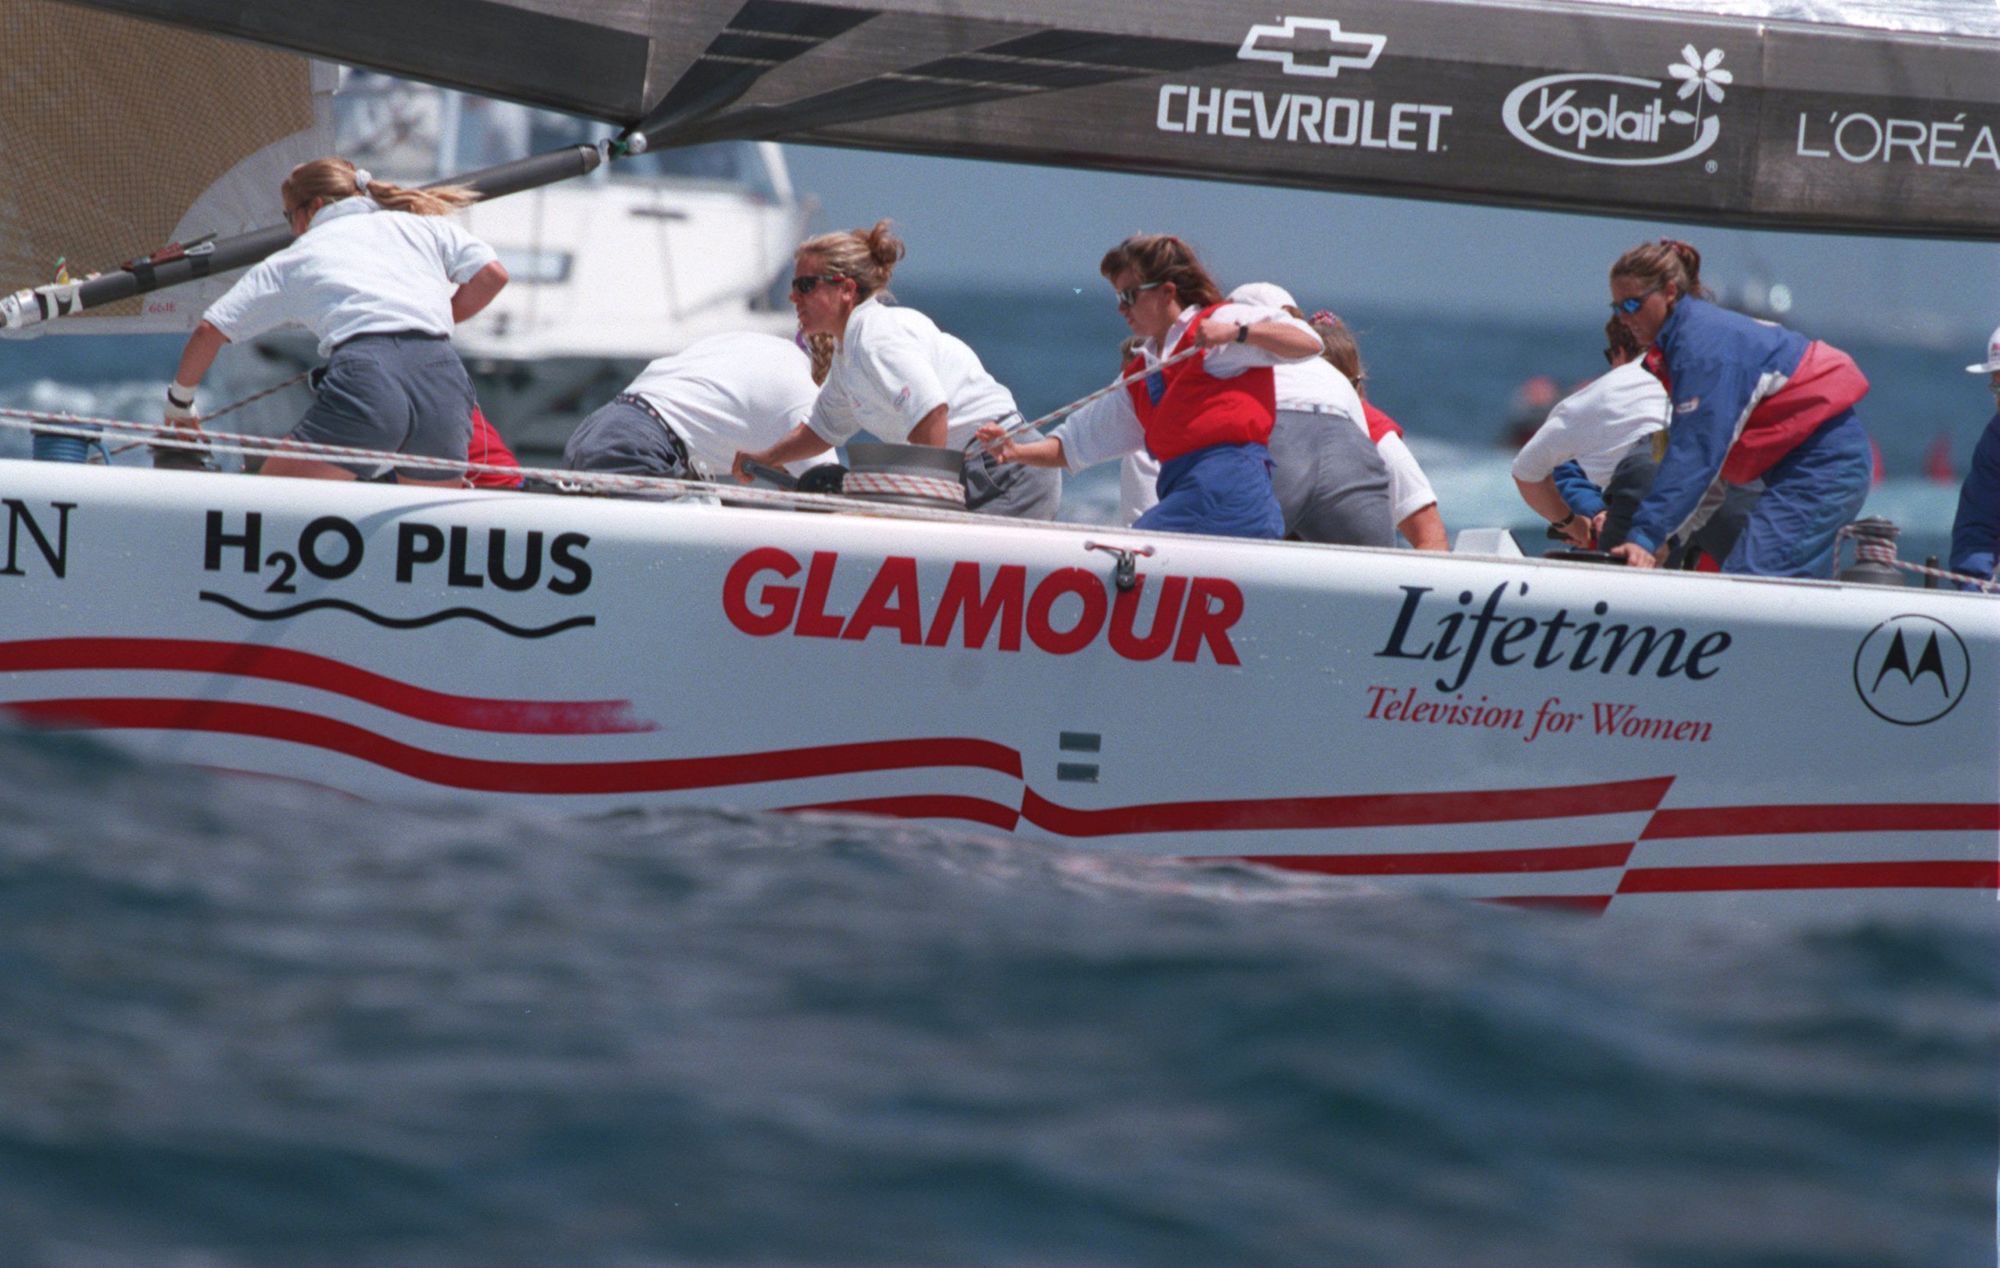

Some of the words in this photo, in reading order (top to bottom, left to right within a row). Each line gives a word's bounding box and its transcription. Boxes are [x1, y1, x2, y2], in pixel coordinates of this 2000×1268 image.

[1156, 84, 1453, 152] CHEVROLET
[1526, 87, 1666, 149] Yoplait
[396, 522, 592, 595] PLUS
[722, 546, 1244, 667] GLAMOUR
[1374, 581, 1732, 692] Lifetime
[1365, 686, 1524, 729] Television
[1524, 697, 1583, 743] for
[1592, 702, 1713, 742] Women
